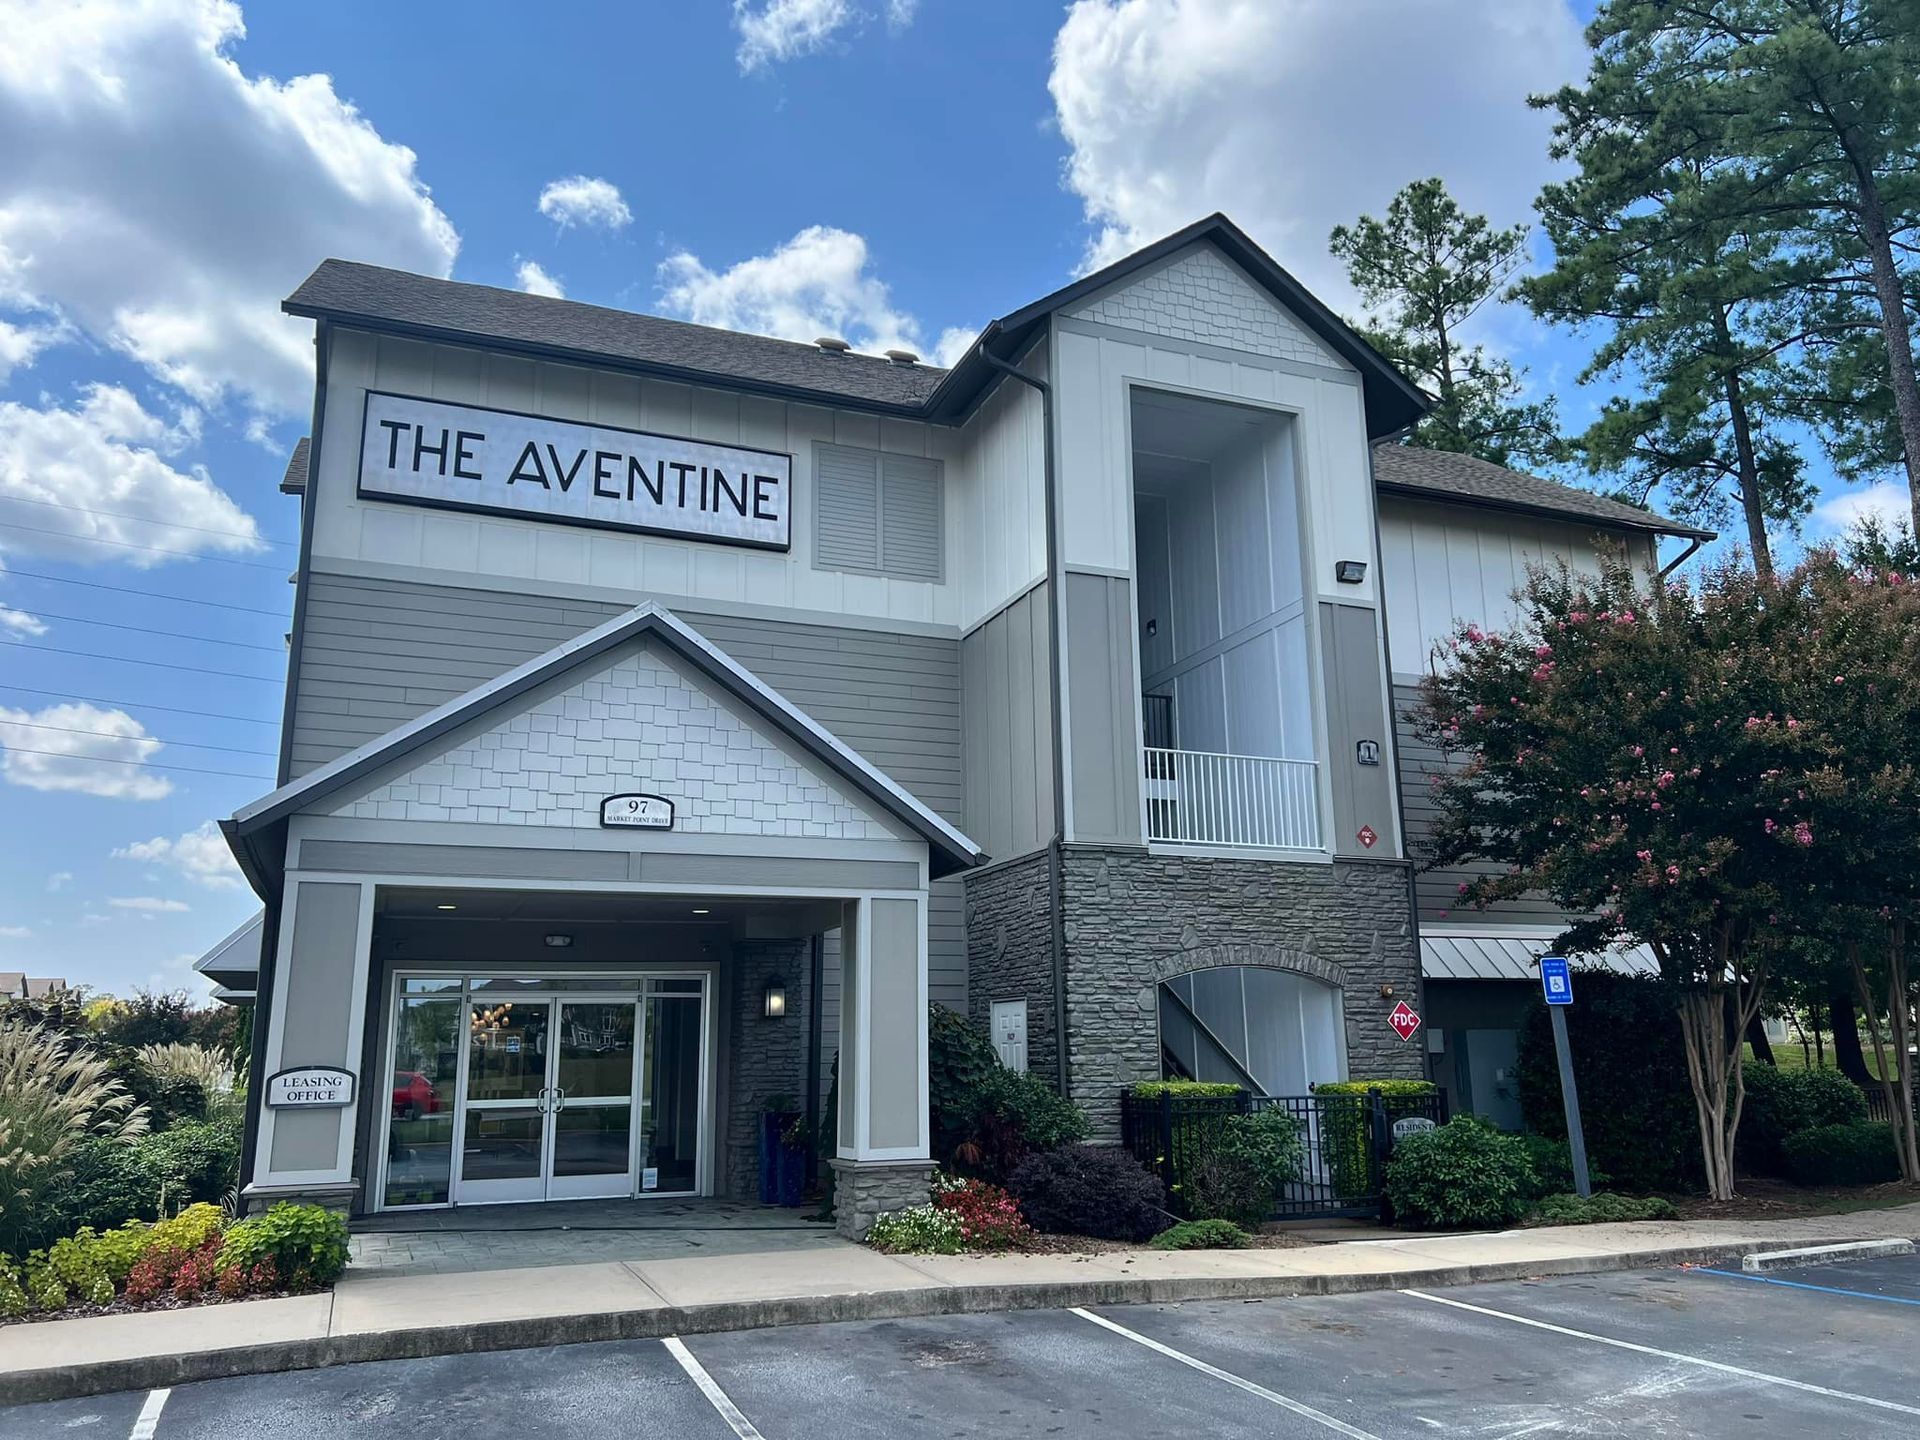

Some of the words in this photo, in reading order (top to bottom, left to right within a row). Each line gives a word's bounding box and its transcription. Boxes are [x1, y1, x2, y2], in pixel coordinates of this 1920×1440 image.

[380, 419, 486, 481] THE
[506, 440, 779, 521] AVENTINE
[628, 800, 649, 814] 97
[607, 815, 631, 823] MARKET
[632, 816, 650, 824] POINT
[651, 817, 669, 825] DRIVE
[1393, 1013, 1415, 1027] FDC
[283, 1076, 342, 1088] LEASING
[287, 1090, 336, 1101] OFFICE
